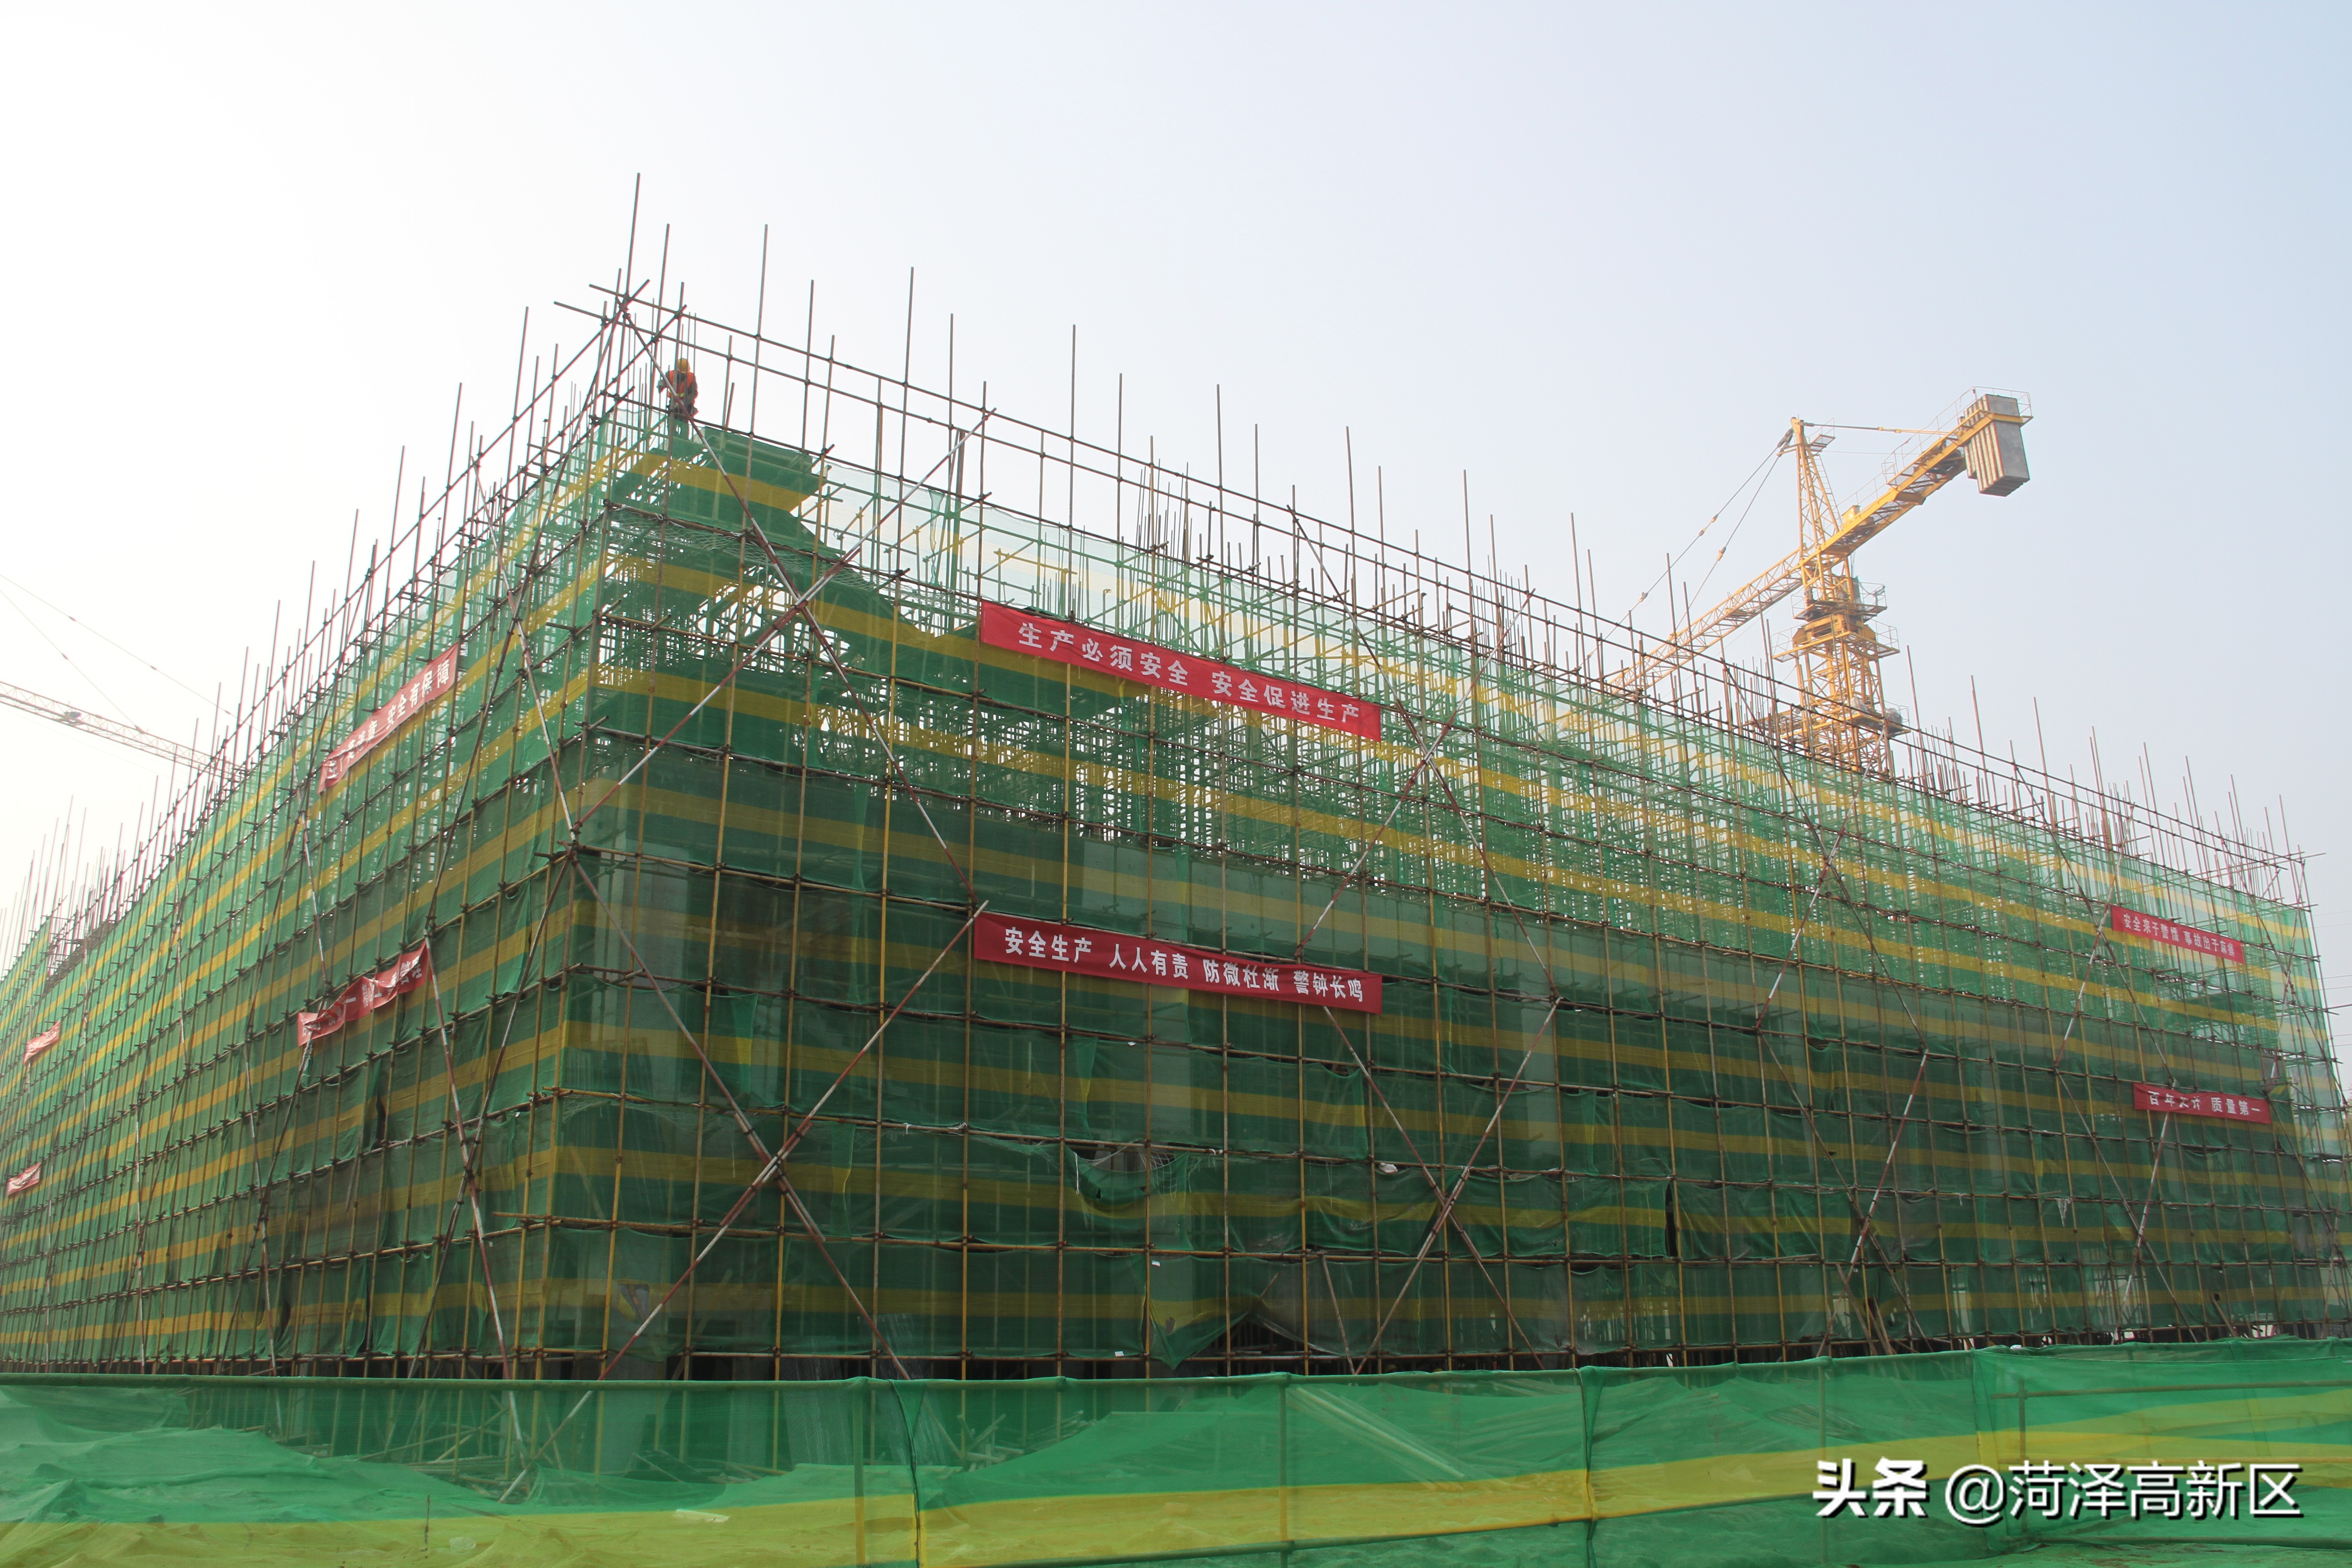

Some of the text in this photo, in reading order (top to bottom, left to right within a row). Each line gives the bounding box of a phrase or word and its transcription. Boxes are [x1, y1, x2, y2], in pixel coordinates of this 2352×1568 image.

[386, 659, 450, 730] 安全有保障
[1018, 622, 1359, 723] 生产必须安全 安全促进生产
[1005, 927, 1362, 1002] 安全生产 人人有责 防微杜渐 警钟长鸣
[2211, 1097, 2260, 1116] 质量第一
